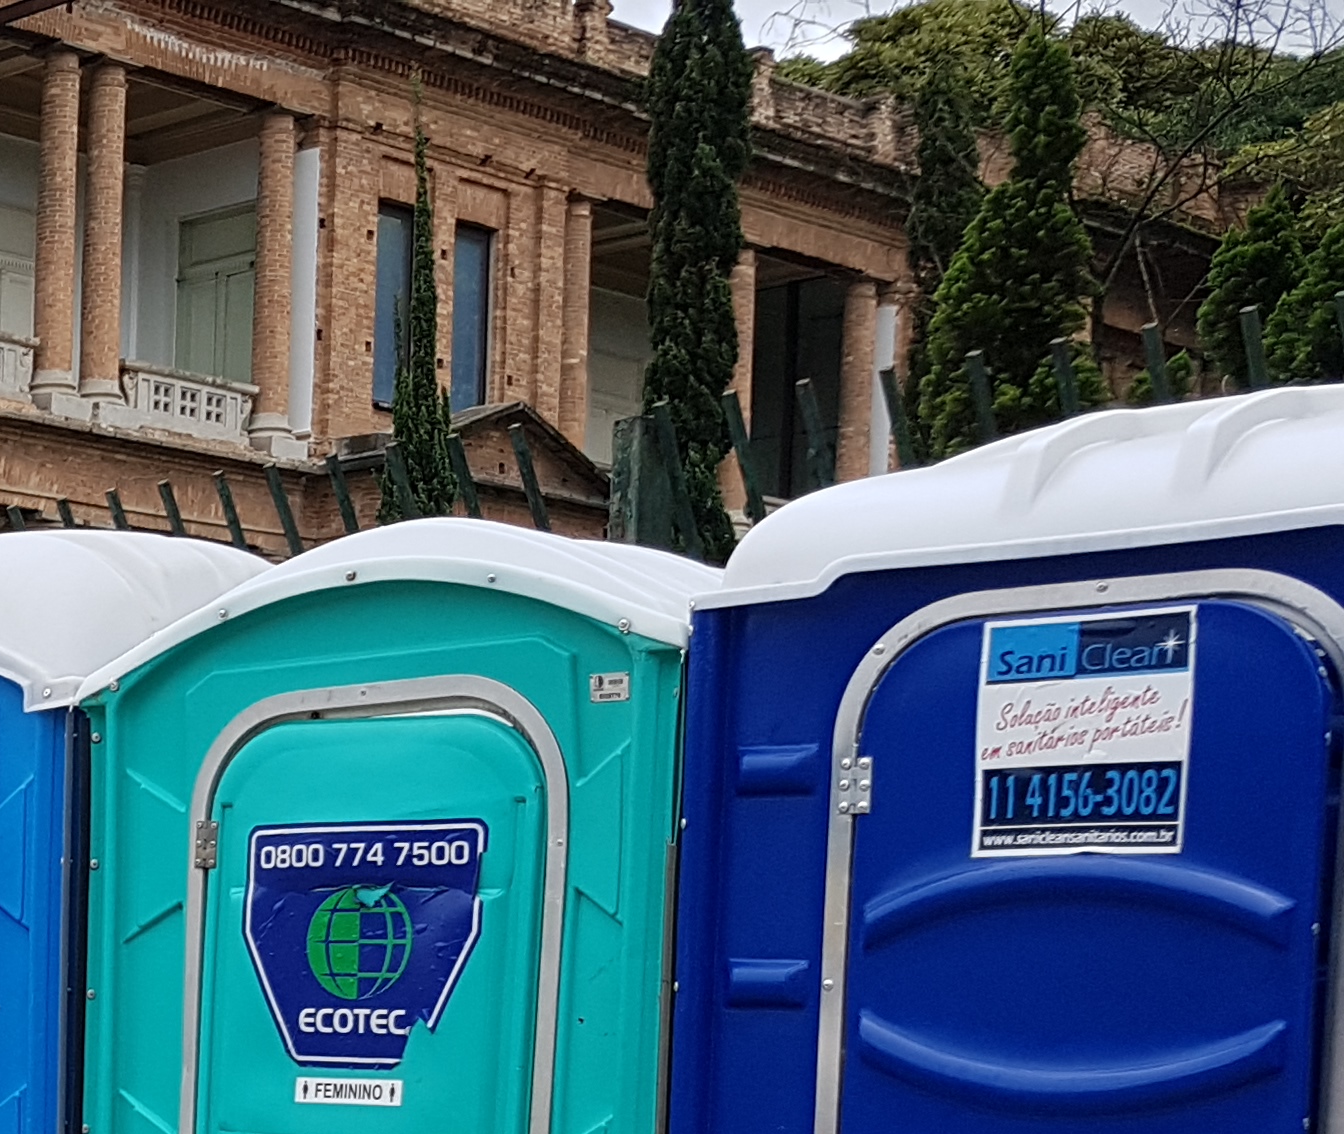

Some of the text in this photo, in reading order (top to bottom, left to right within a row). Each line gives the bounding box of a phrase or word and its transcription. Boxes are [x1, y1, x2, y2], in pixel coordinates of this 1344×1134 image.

[996, 641, 1175, 676] Sani Clean
[1064, 685, 1162, 722] inteligente
[981, 698, 1189, 761] em sanitários portáteis!
[988, 768, 1178, 819] 11 4156-3082
[260, 840, 471, 870] 0800 774 7500
[298, 1008, 406, 1035] ECOTEC
[314, 1082, 384, 1101] FEMININO
